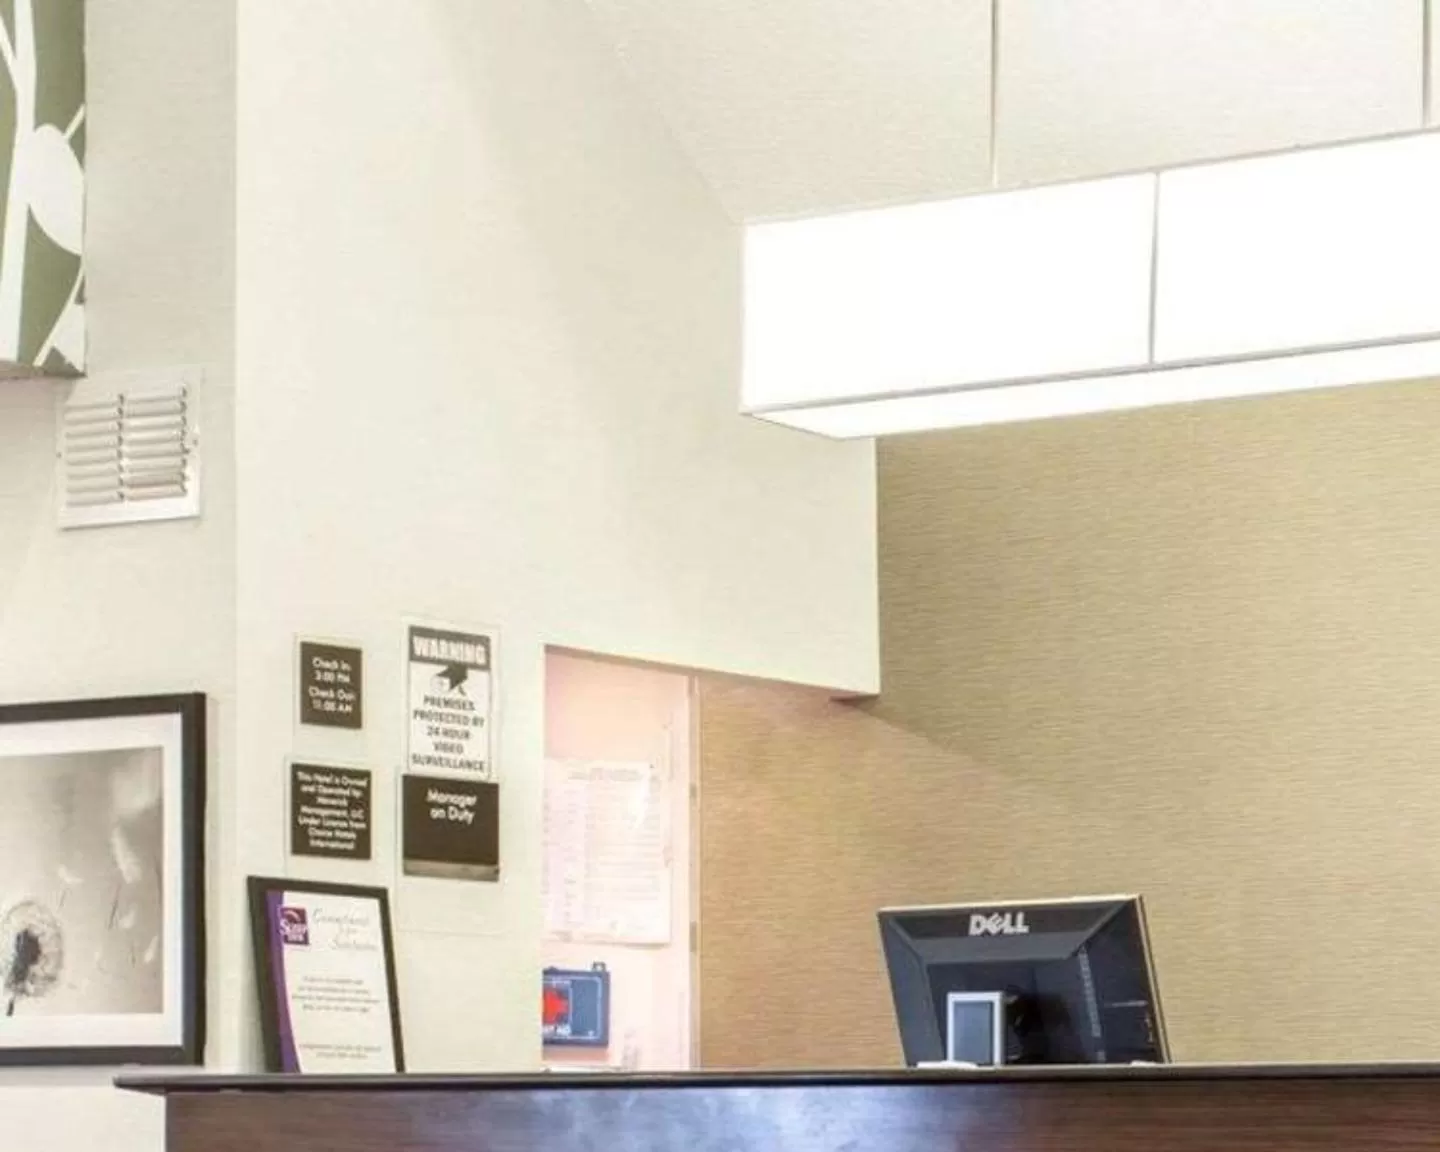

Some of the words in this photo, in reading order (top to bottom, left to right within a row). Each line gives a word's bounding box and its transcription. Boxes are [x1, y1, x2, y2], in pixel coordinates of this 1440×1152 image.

[412, 635, 486, 665] WARNING
[311, 656, 339, 670] Check
[308, 686, 335, 699] Check
[423, 695, 476, 712] PREMISES
[412, 709, 471, 727] PROTECTED
[471, 715, 485, 729] BY
[426, 725, 440, 737] 24
[441, 727, 470, 741] HOUR
[432, 741, 465, 755] VIDEO
[412, 752, 486, 773] SURVEILLANCE
[426, 788, 478, 809] Manager
[429, 806, 447, 821] on
[447, 804, 477, 826] Duty
[968, 911, 1030, 937] DELL
